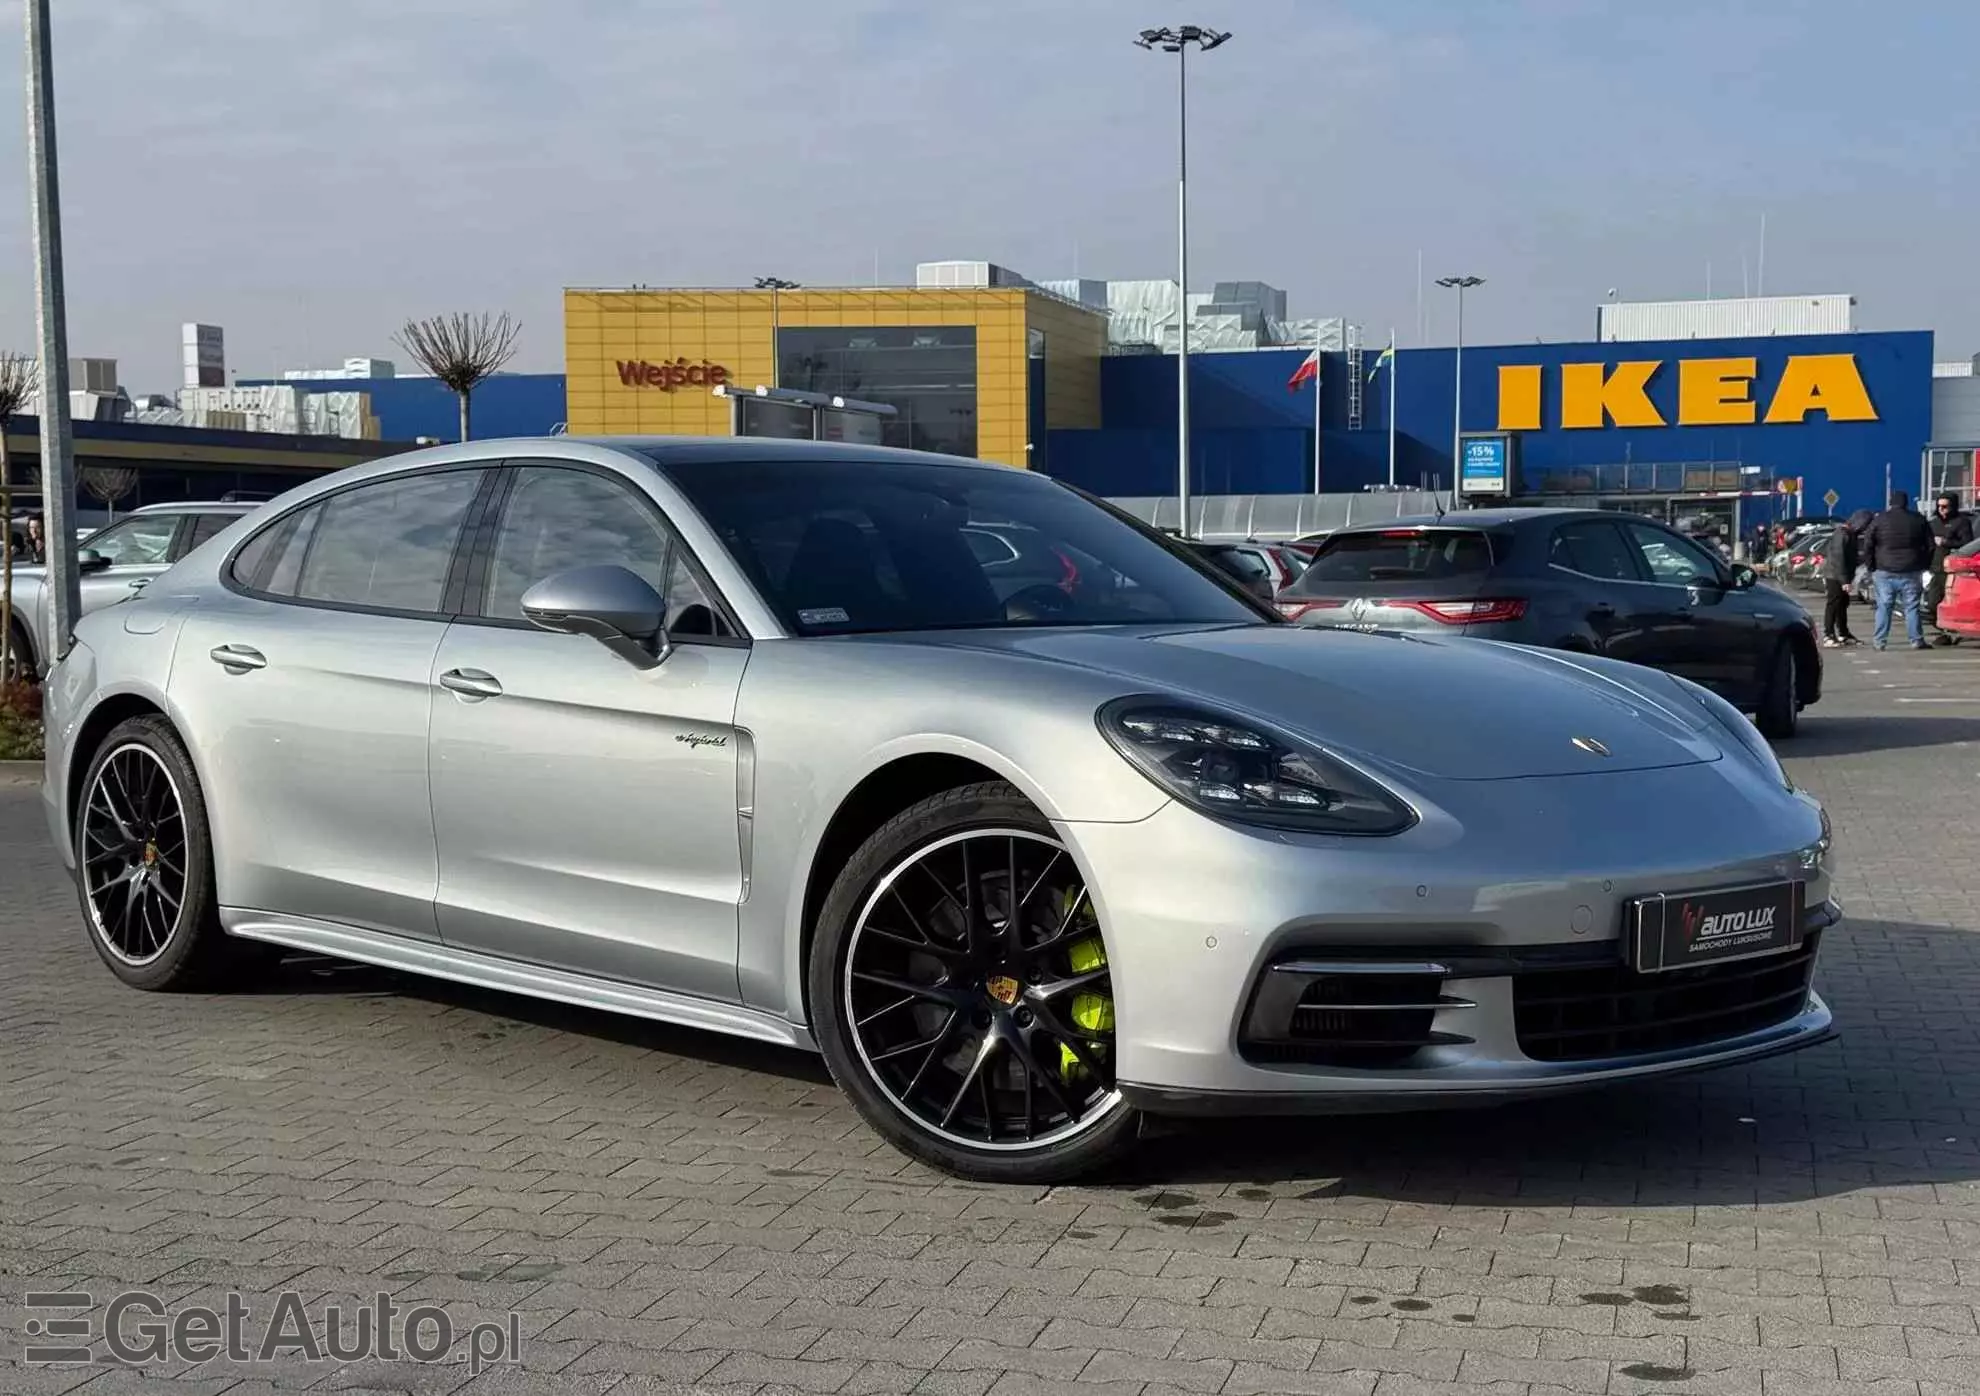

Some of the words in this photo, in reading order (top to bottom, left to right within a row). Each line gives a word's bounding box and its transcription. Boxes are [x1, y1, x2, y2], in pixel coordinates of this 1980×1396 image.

[616, 357, 727, 393] Wejście
[1497, 353, 1880, 430] IKEA
[1746, 906, 1776, 929] LUX
